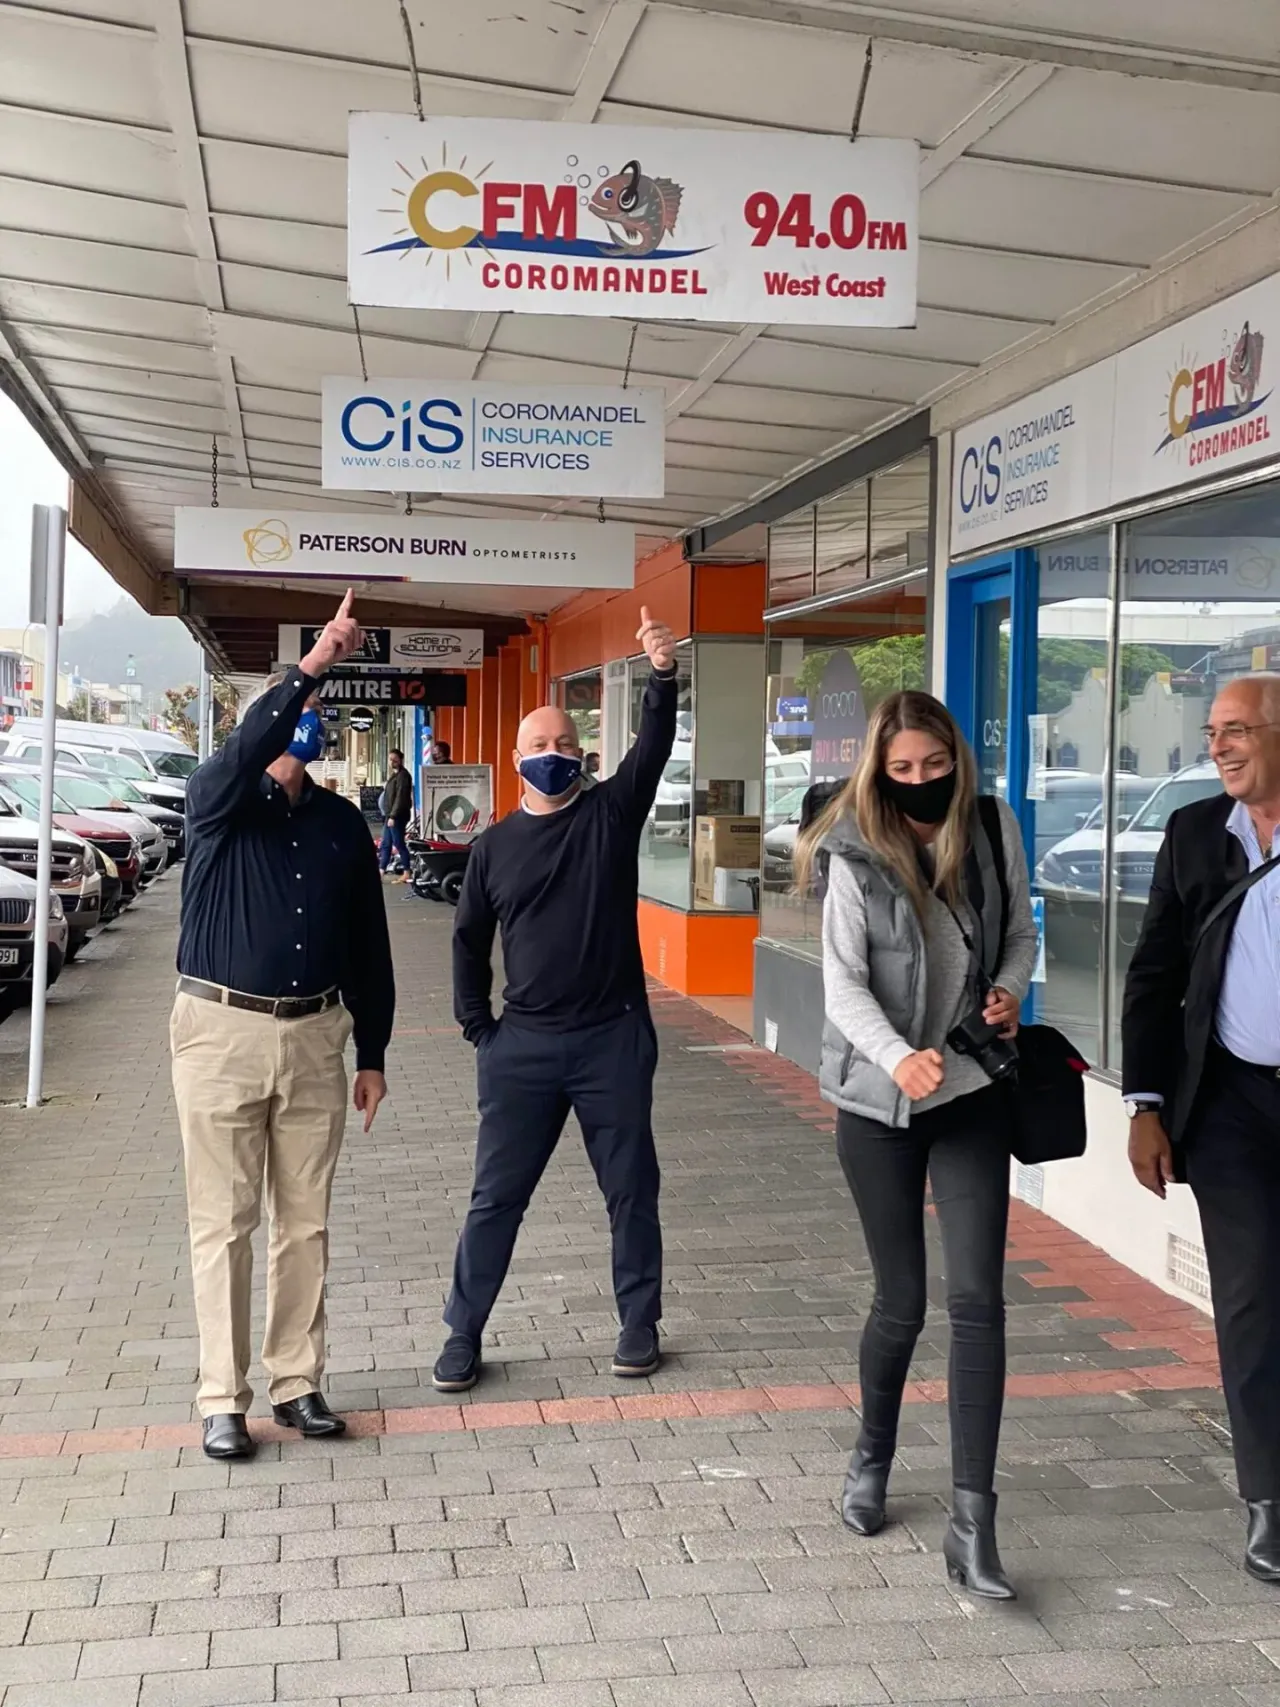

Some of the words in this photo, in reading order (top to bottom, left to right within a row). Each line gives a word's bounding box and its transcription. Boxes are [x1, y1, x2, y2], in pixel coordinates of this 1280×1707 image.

[482, 263, 708, 295] COROMANDEL
[763, 271, 822, 297] West
[825, 272, 887, 299] Coast
[482, 402, 646, 423] COROMANDEL
[482, 427, 613, 446] INSURANCE
[1008, 404, 1075, 450] COROMANDEL
[1188, 415, 1270, 467] COROMANDEL
[341, 456, 462, 469] WWW.CIS.CO.NZ
[481, 451, 590, 470] SERVICES
[1006, 443, 1060, 483] INSURANCE
[1004, 480, 1048, 513] SERVICES
[299, 533, 403, 554] PATERSON
[409, 537, 467, 556] BURN
[472, 548, 577, 561] OPTOMETRISTS
[319, 679, 392, 699] MITRE
[398, 680, 425, 700] 10
